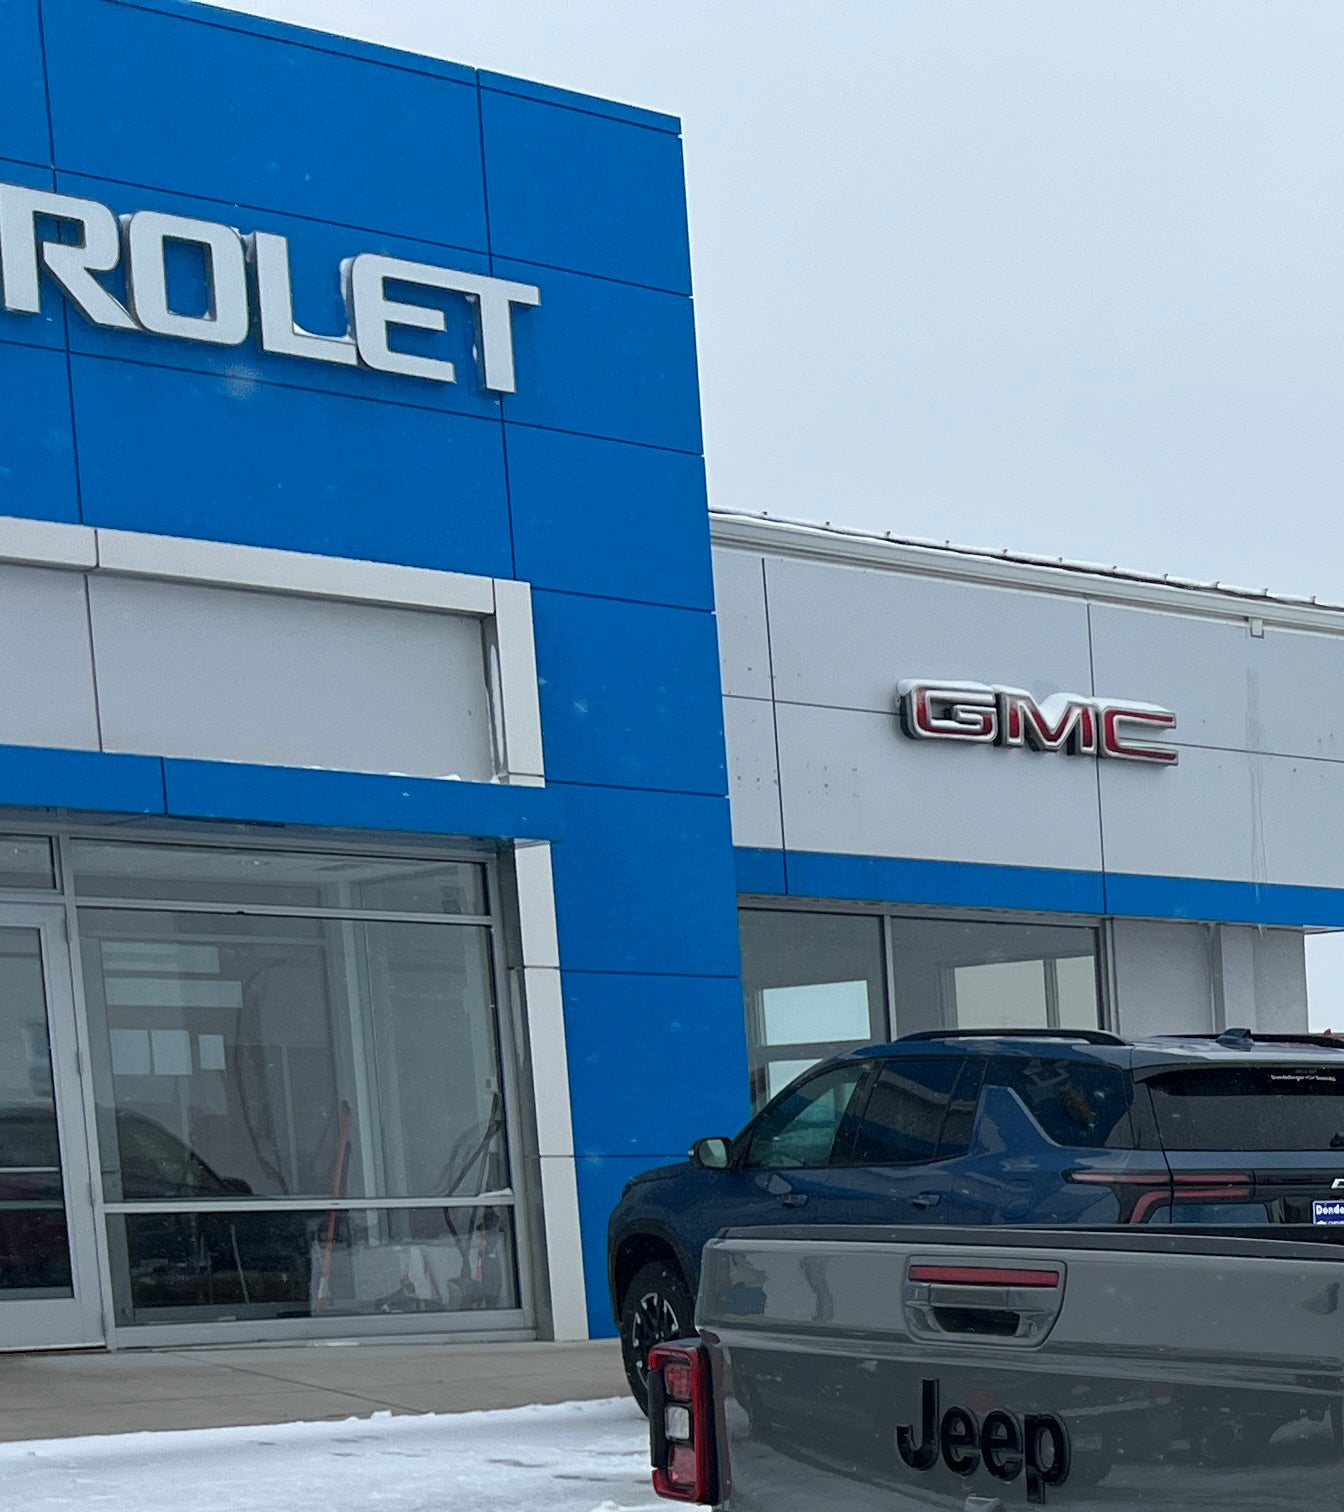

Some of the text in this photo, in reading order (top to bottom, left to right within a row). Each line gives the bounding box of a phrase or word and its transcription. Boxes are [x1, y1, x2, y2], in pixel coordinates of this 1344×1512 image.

[0, 183, 541, 394] ROLET
[903, 681, 1179, 766] GMC
[896, 1377, 1072, 1505] Jeep
